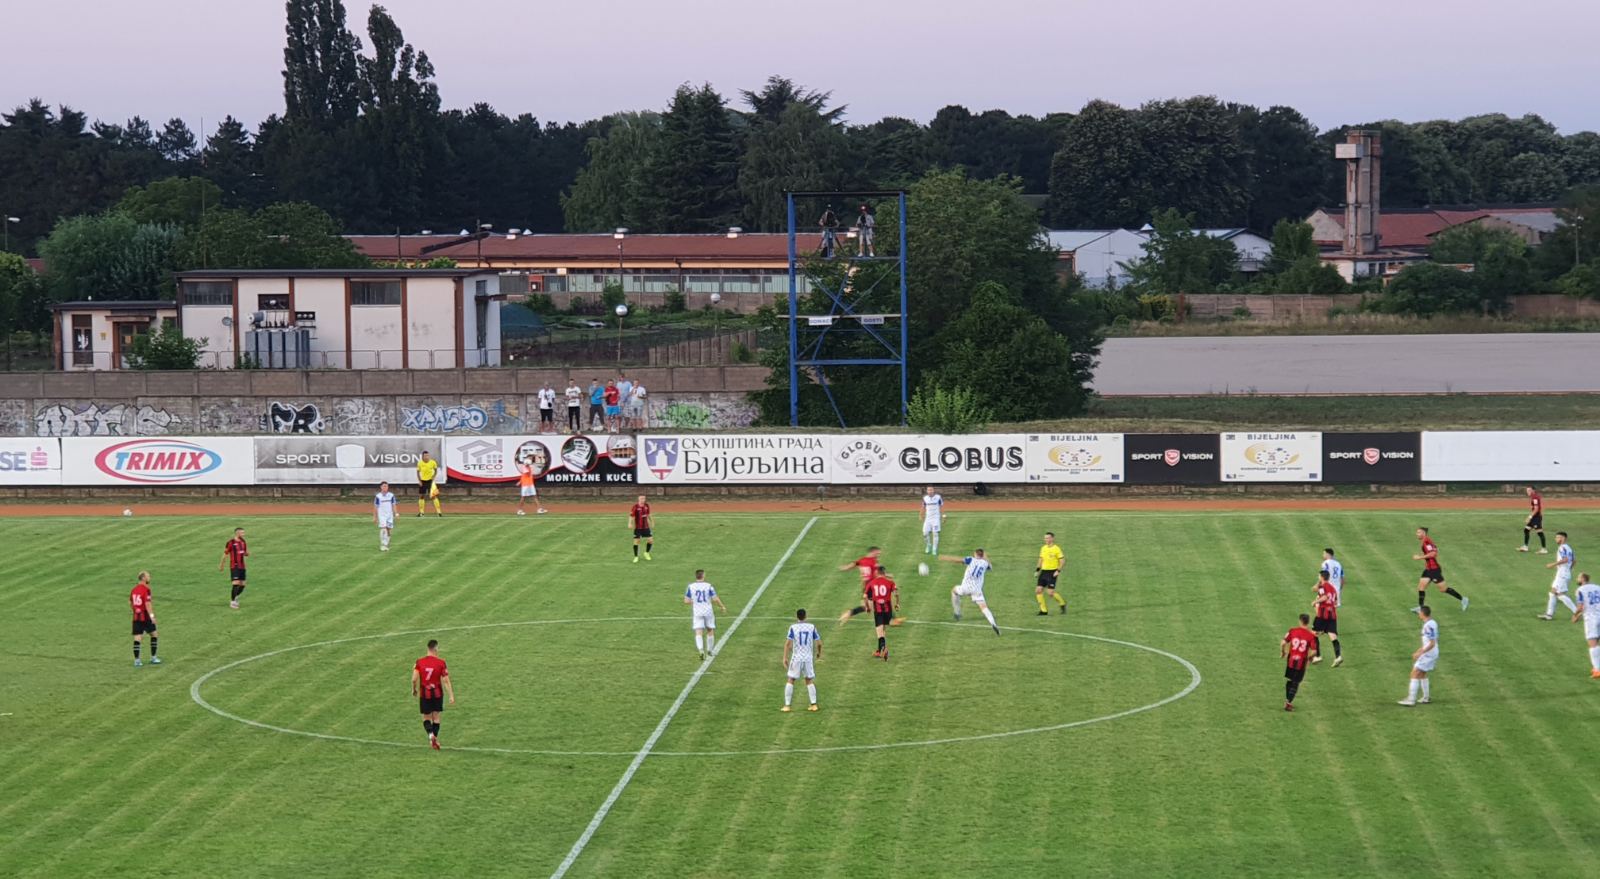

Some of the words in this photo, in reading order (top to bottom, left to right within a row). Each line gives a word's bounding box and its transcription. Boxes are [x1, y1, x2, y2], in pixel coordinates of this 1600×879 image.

[1247, 433, 1296, 441] BIJELJINA
[681, 438, 775, 450] СКУПШТИНА
[778, 438, 823, 450] ГРАДА
[841, 441, 888, 460] GLOBUS
[115, 452, 207, 471] TRIMIX
[275, 454, 331, 465] SPORT
[369, 454, 423, 464] VISION
[684, 450, 824, 481] Бијељина
[898, 446, 1024, 472] GLOBUS
[463, 463, 504, 471] STECO
[546, 472, 601, 482] MONTAŽNE
[695, 590, 707, 603] 21
[873, 584, 888, 597] 10
[132, 594, 143, 606] 16
[798, 631, 810, 646] 17
[1291, 637, 1308, 652] 93
[425, 667, 435, 681] 7
